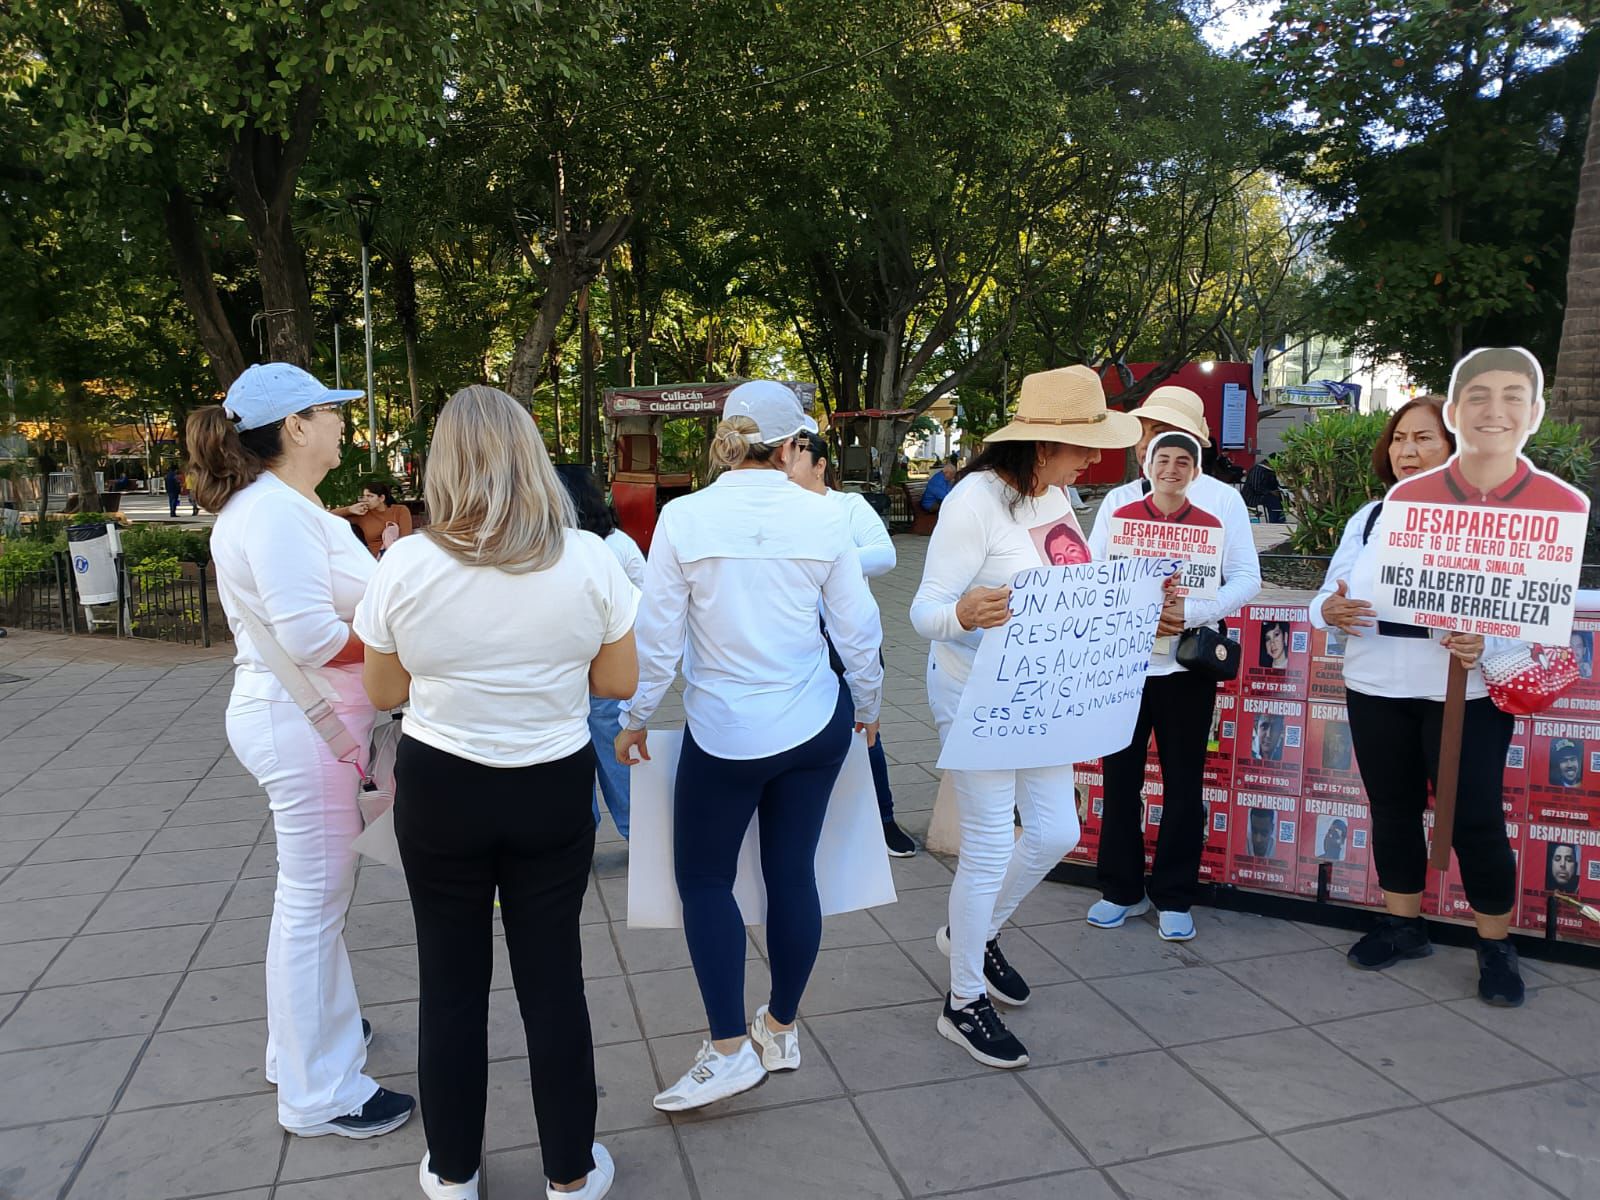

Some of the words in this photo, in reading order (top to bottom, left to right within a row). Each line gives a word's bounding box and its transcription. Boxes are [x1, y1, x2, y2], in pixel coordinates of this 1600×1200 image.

[649, 401, 681, 411] Ciudad
[682, 400, 716, 412] Capital
[1123, 521, 1208, 545] DESAPARECIDO
[1405, 506, 1560, 544] DESAPARECIDO
[1113, 535, 1134, 546] DESDE
[1136, 537, 1145, 547] 16
[1147, 538, 1156, 548] DE
[1157, 540, 1180, 551] ENERO
[1182, 542, 1195, 553] DEL
[1197, 544, 1217, 555] 2025
[1389, 531, 1426, 549] DESDE
[1429, 535, 1441, 551] 16
[1446, 536, 1461, 552] DE
[1465, 537, 1505, 557] ENERO
[1509, 542, 1532, 559] DEL
[1538, 544, 1574, 563] 2025
[1422, 553, 1434, 566] EN
[1013, 570, 1050, 590] UN
[1097, 560, 1132, 585] SIN
[1186, 562, 1217, 578] JESÚS
[1381, 561, 1414, 587] INÉS
[1418, 568, 1485, 596] ALBERTO
[1490, 577, 1513, 599] DE
[1517, 577, 1573, 606] JESÚS
[1008, 592, 1048, 617] UN
[1054, 586, 1097, 612] AÑO
[1103, 583, 1131, 609] SIN
[1393, 588, 1444, 613] IBARRA
[1450, 594, 1550, 627] BERRELLEZA
[1249, 607, 1308, 622] DESAPARECIDA
[1004, 609, 1143, 649] RESPUESTAS
[1461, 617, 1472, 632] TU
[1475, 619, 1521, 639] REGRESO!
[996, 654, 1047, 682] LAS
[1251, 681, 1266, 690] 667
[1267, 682, 1279, 691] 157
[1280, 684, 1297, 692] 1930
[973, 706, 1011, 723] CES
[1022, 706, 1046, 720] EN
[1051, 699, 1085, 719] LAS
[1243, 699, 1302, 717] DESAPARECIDO
[972, 722, 1048, 738] CIONES
[1534, 721, 1600, 740] DESAPARECID
[1244, 774, 1259, 783] 667
[1260, 775, 1272, 785] 157
[1273, 777, 1290, 787] 1930
[1313, 782, 1328, 792] 667
[1329, 784, 1342, 793] 157
[1342, 786, 1360, 796] 1930
[1237, 791, 1296, 812] DESAPARECIDO
[1305, 799, 1368, 819] DESAPARECIDO
[1238, 868, 1252, 878] 667
[1453, 900, 1470, 909] 667
